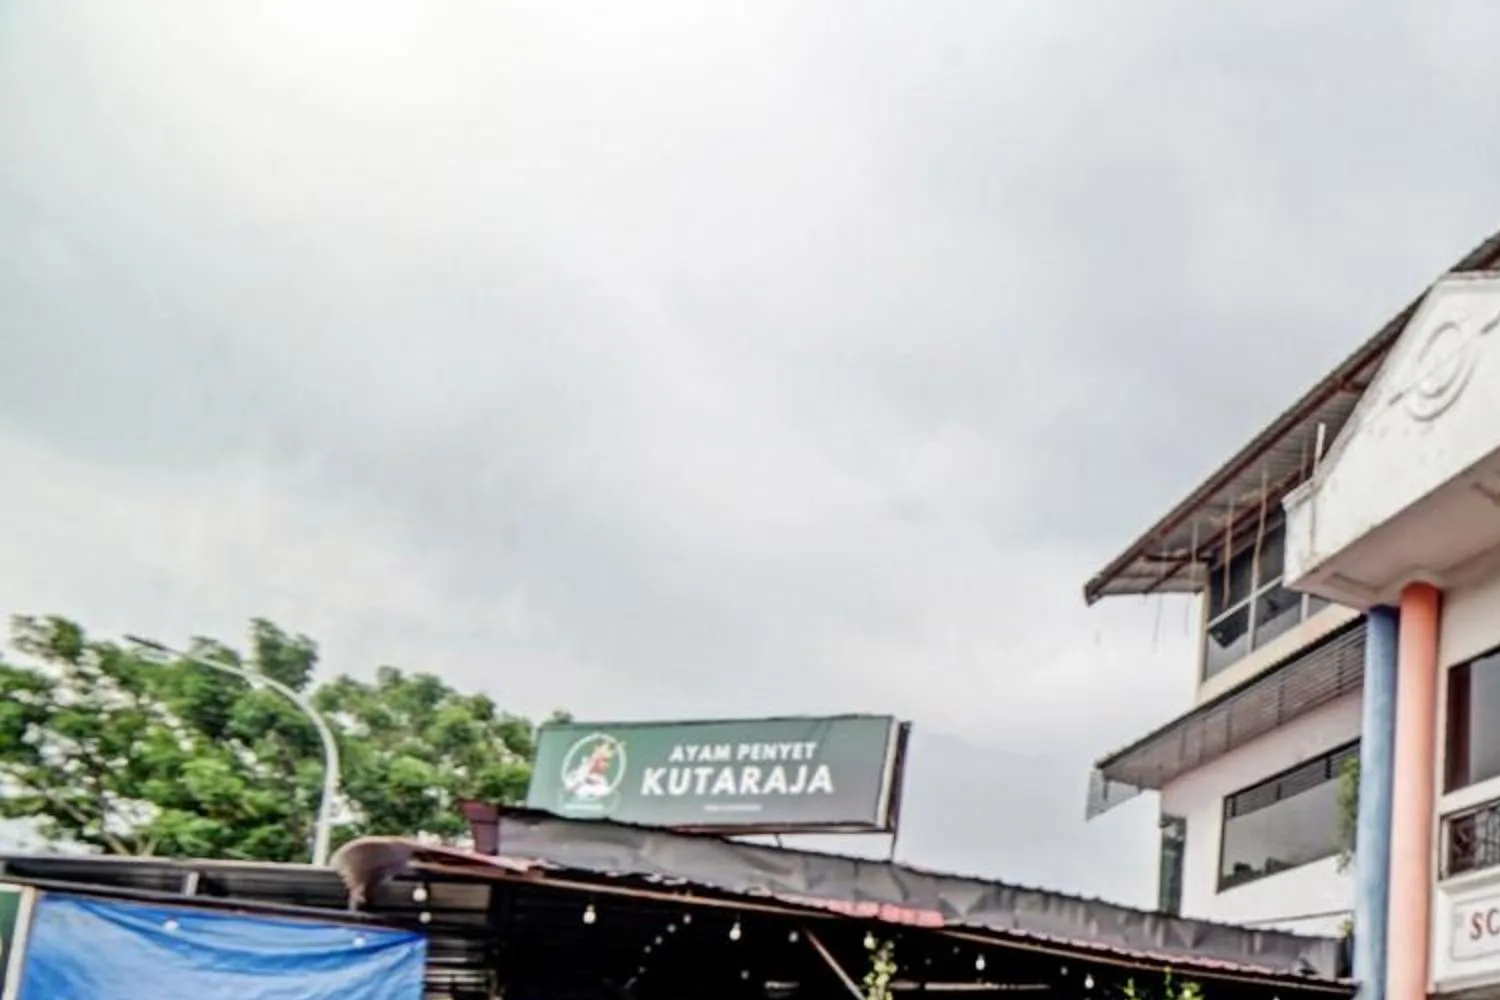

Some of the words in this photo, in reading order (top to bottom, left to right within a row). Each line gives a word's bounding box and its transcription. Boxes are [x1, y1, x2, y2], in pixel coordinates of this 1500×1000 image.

[668, 743, 731, 763] AYAM
[736, 741, 817, 761] PENYET
[640, 764, 834, 796] KUTARAJA
